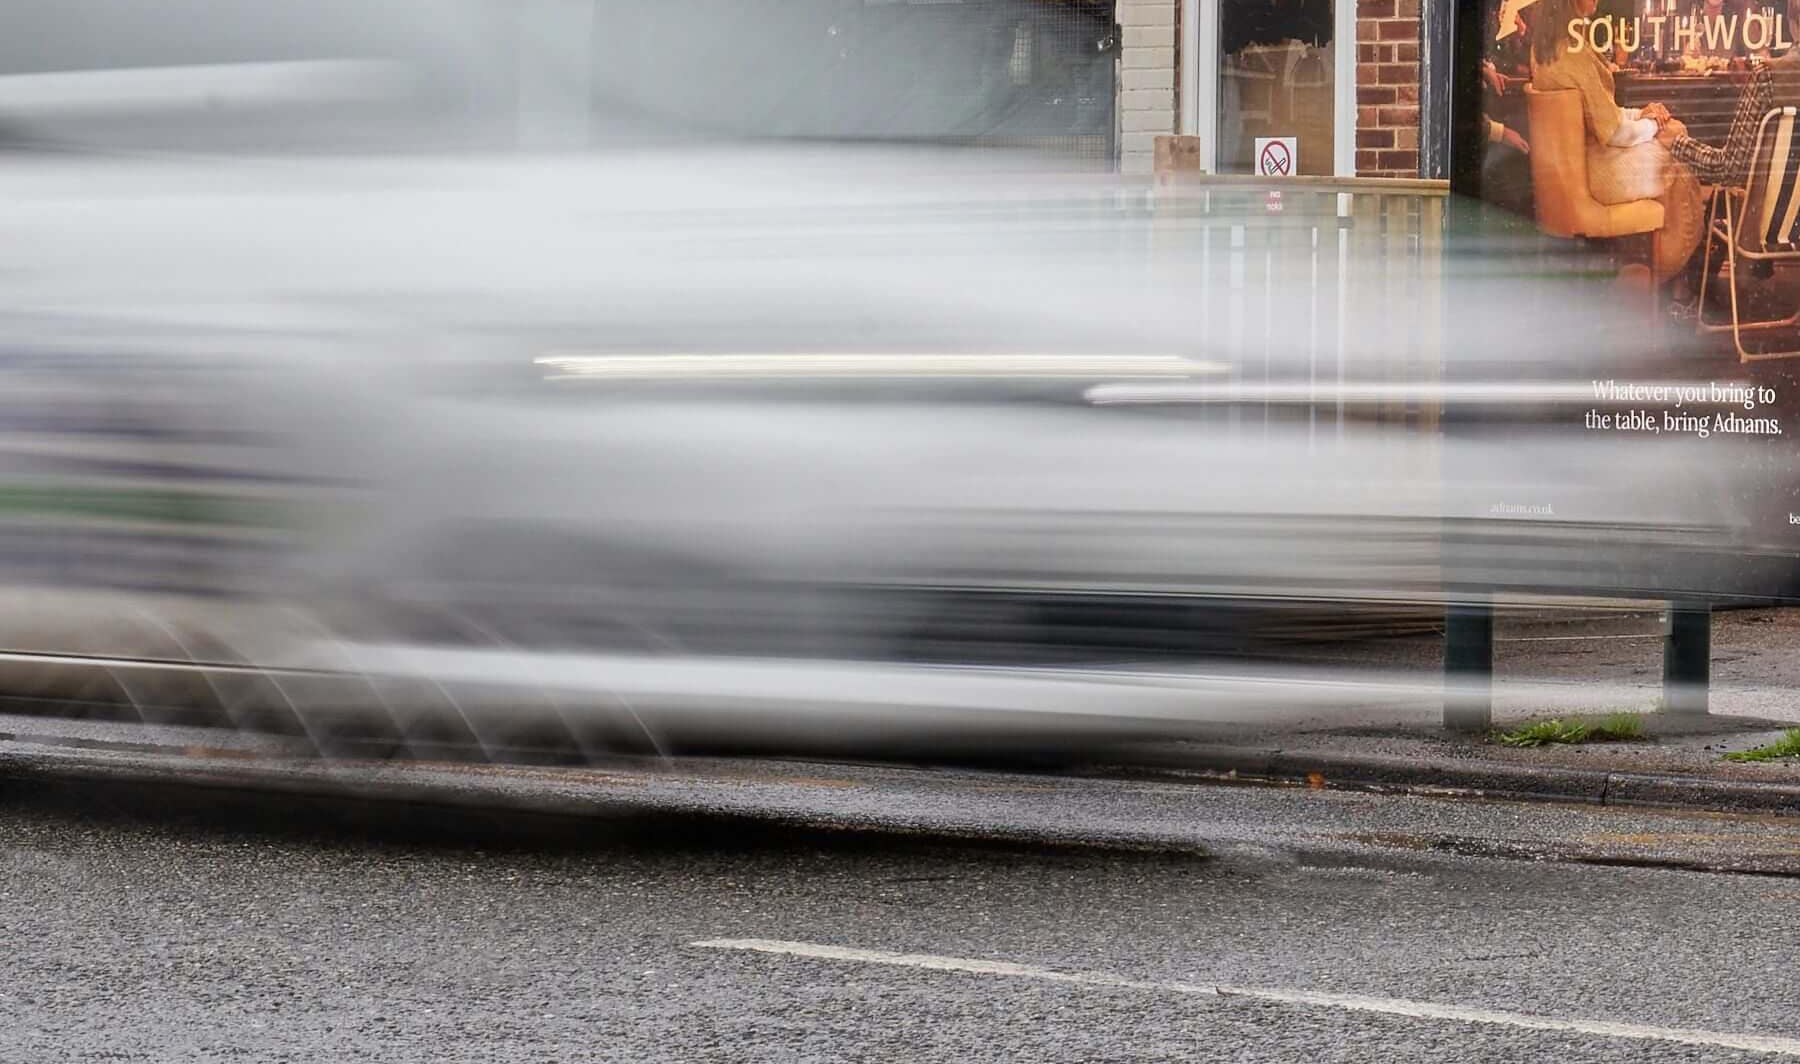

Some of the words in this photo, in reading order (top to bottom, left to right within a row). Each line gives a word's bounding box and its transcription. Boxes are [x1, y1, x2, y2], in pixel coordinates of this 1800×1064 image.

[1591, 379, 1669, 401] Whatever
[1674, 386, 1706, 407] you
[1711, 382, 1755, 409] bring
[1758, 386, 1776, 404] to
[1585, 409, 1611, 429] the
[1615, 411, 1660, 434] table,
[1664, 411, 1710, 438] bring
[1713, 412, 1783, 435] Adnams.
